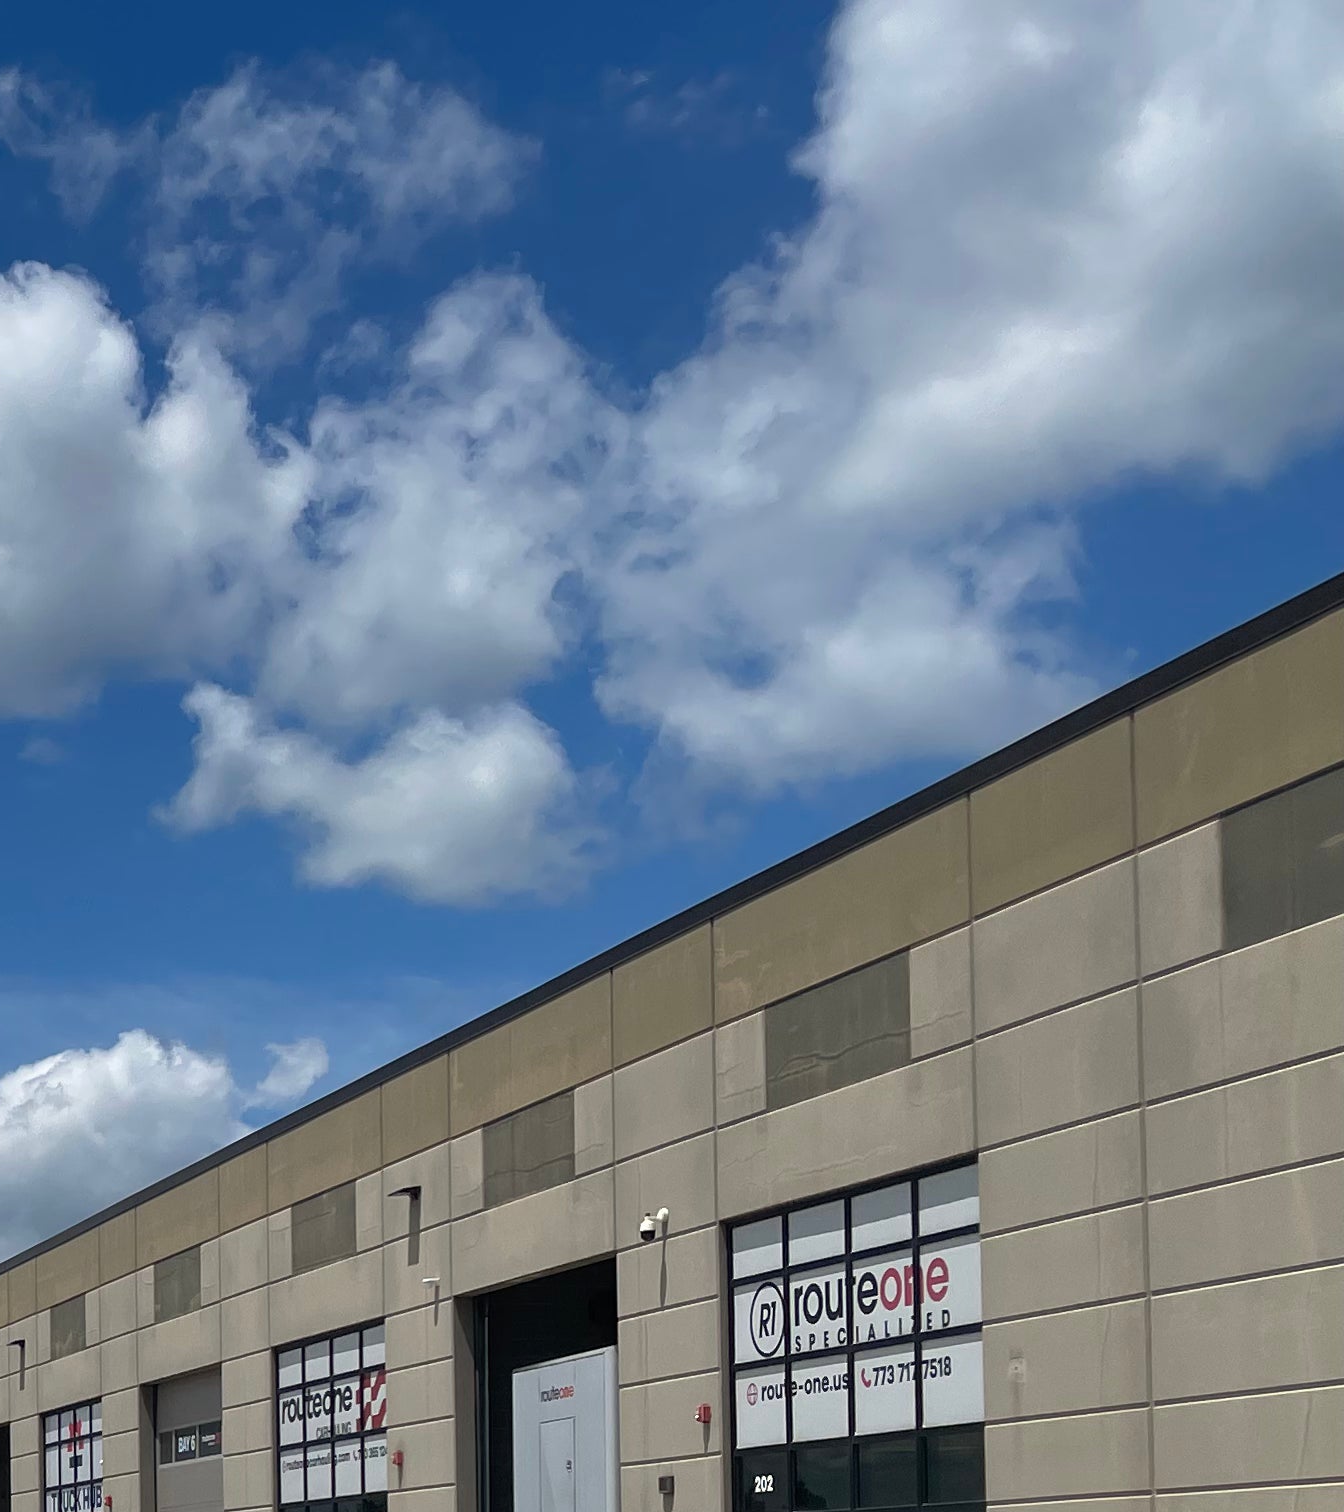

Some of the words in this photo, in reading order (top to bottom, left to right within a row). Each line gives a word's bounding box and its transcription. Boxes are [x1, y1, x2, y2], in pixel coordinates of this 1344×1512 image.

[795, 1309, 951, 1352] SPECIALIED
[873, 1366, 895, 1386] 773
[922, 1355, 952, 1379] 7518
[755, 1474, 774, 1493] 202
